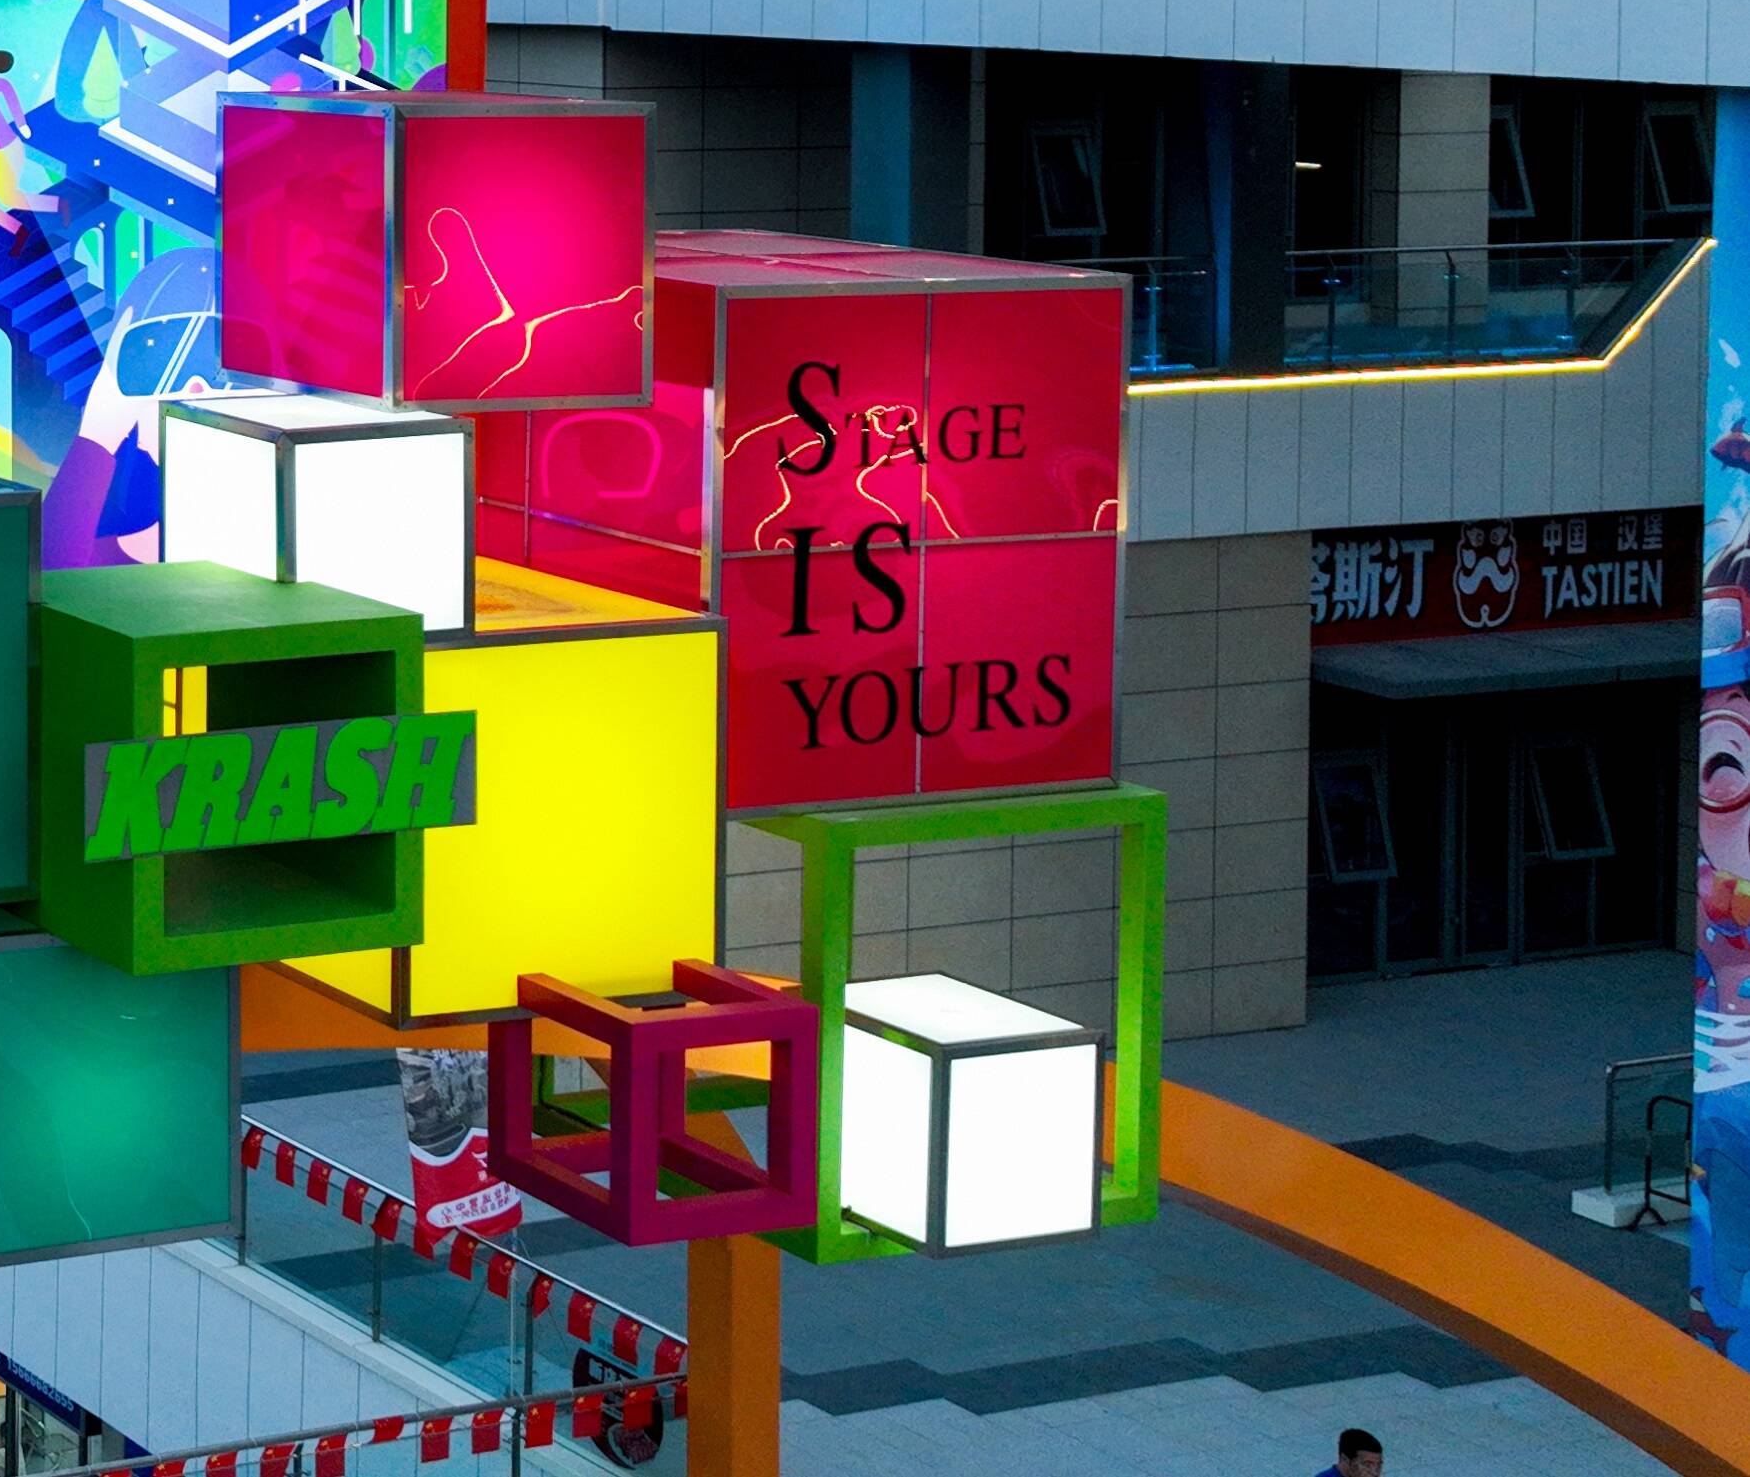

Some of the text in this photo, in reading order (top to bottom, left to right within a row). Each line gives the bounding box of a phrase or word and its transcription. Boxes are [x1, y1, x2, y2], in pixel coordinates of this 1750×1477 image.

[780, 522, 912, 638] IS
[1543, 512, 1664, 556] 中国 汉堡
[1542, 558, 1664, 620] TASTIEN
[783, 654, 1073, 752] YOURS
[85, 713, 475, 862] KRASH
